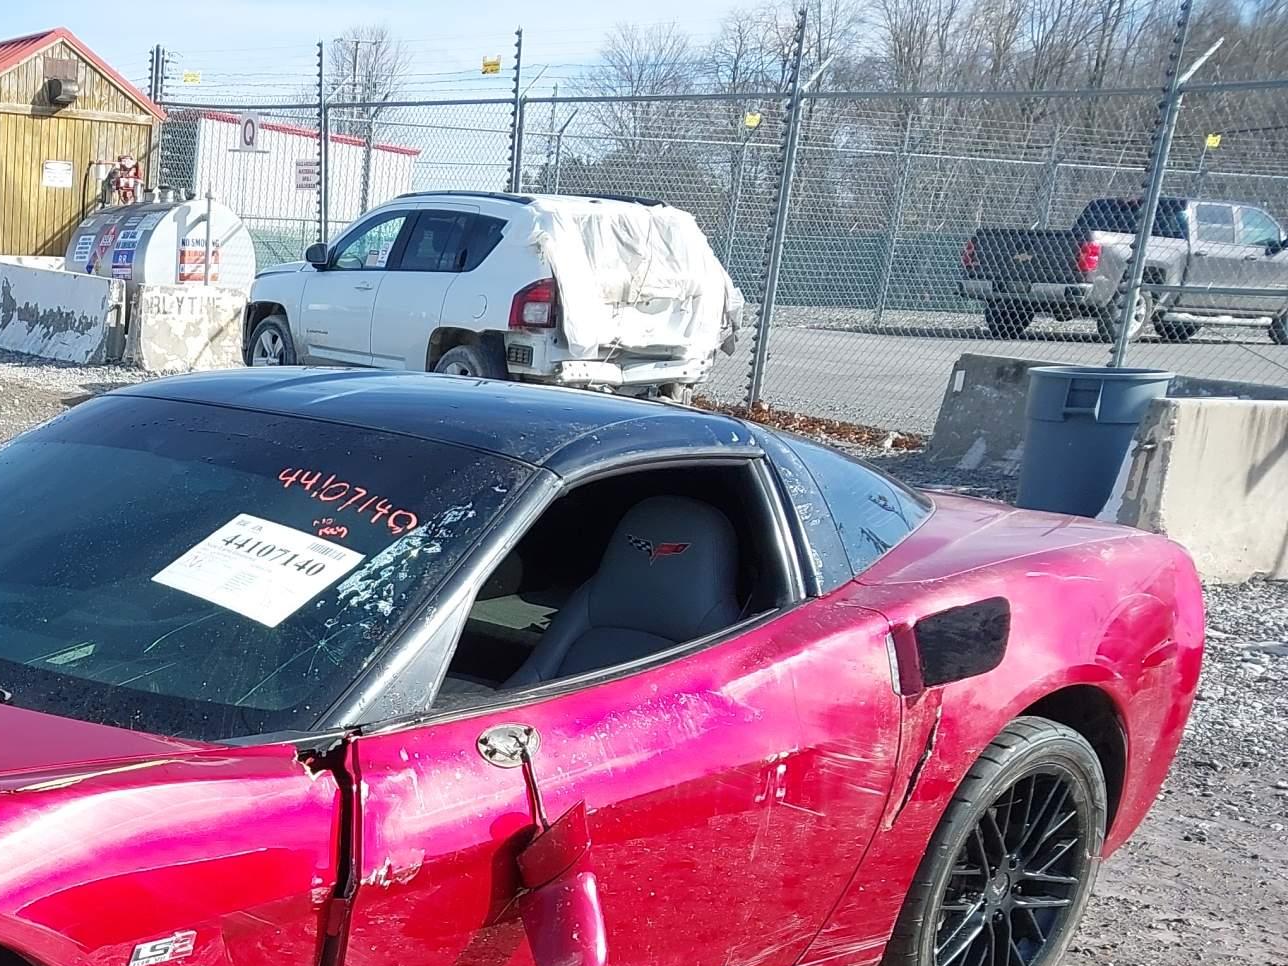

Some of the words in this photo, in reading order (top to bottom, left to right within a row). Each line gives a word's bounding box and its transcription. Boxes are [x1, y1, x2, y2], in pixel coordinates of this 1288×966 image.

[243, 118, 255, 147] Q
[182, 238, 190, 247] NO
[191, 238, 220, 248] SMONG
[222, 534, 327, 577] 44107140
